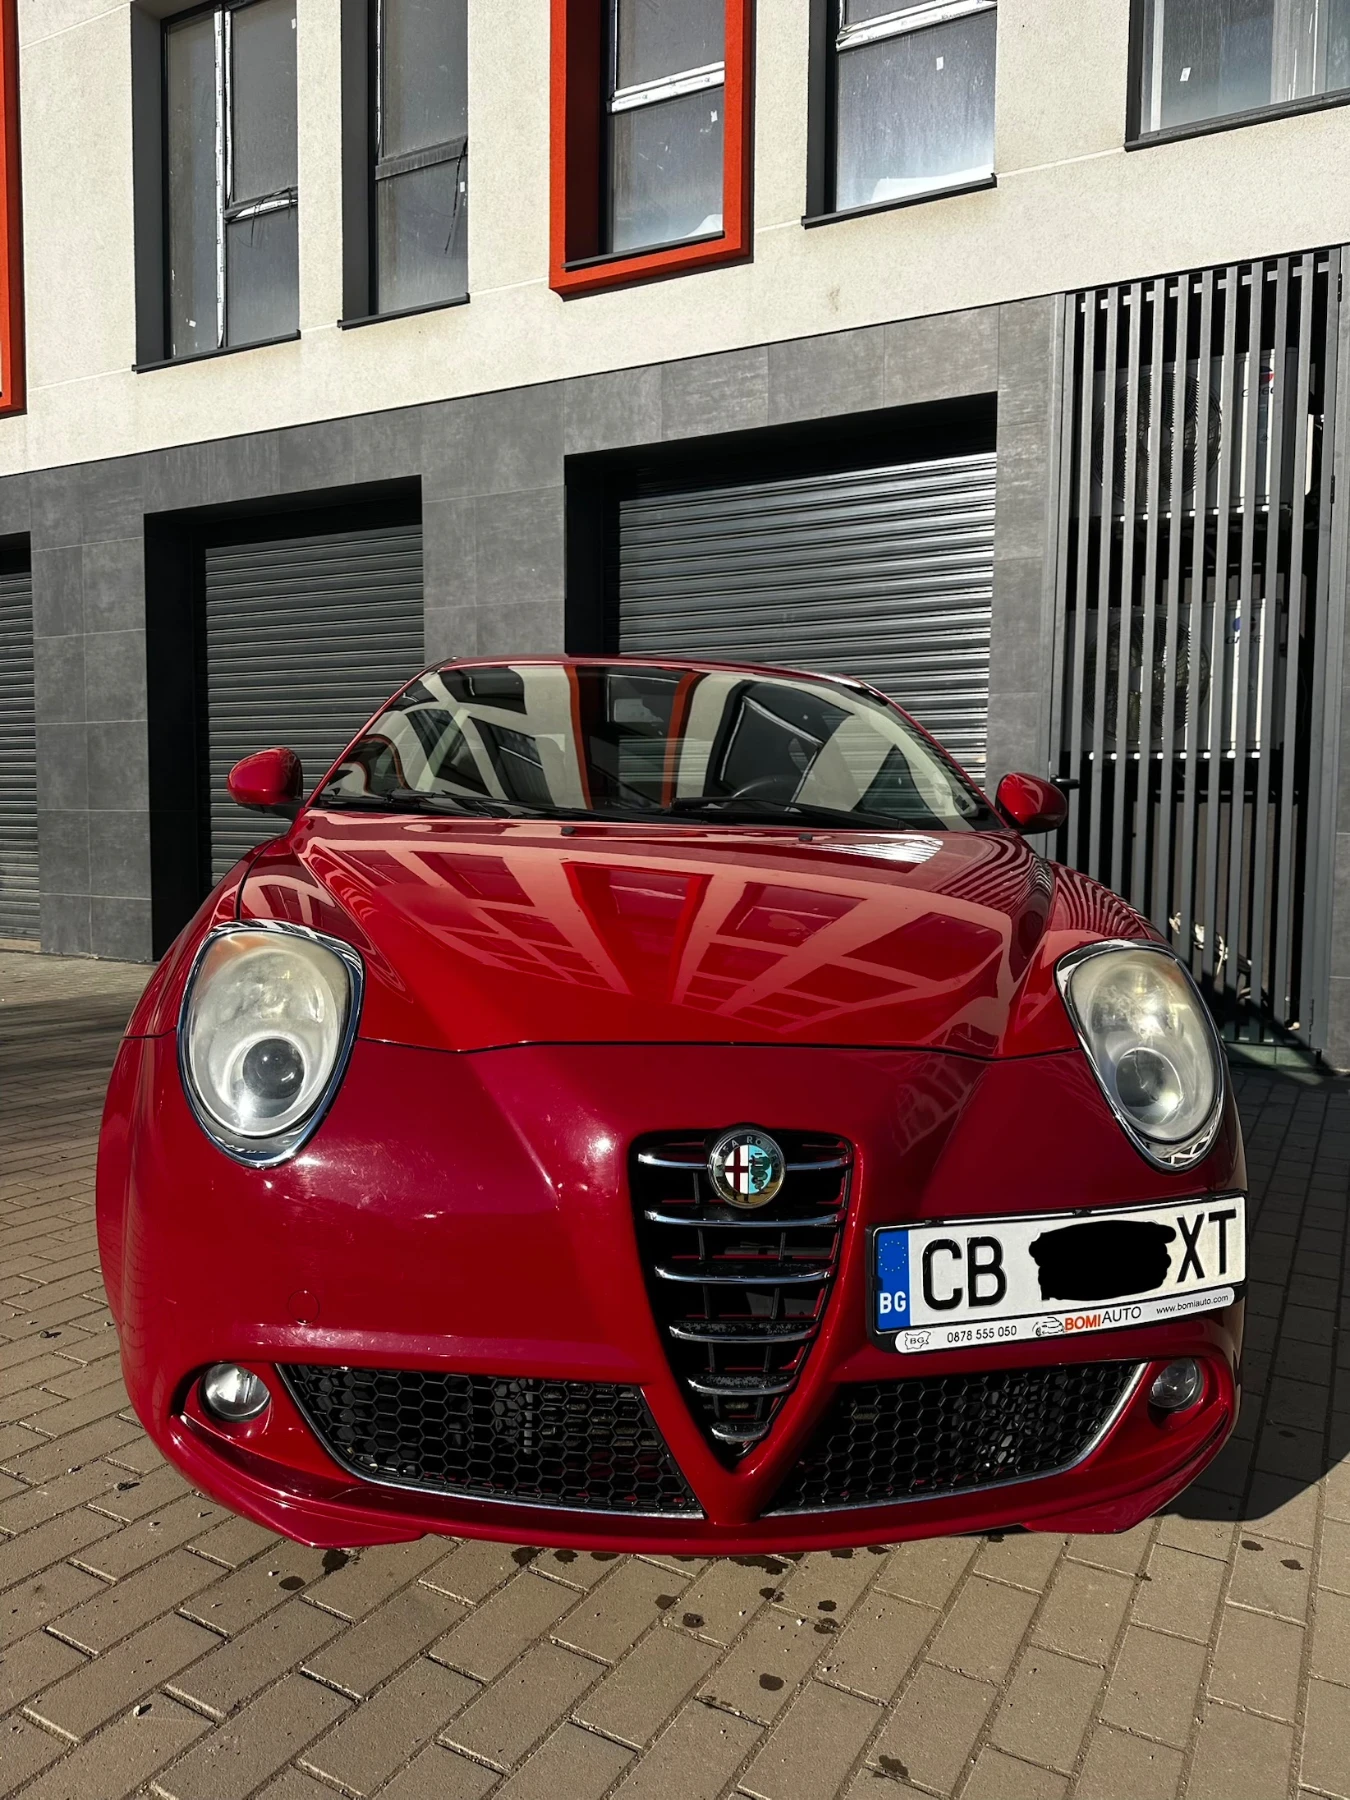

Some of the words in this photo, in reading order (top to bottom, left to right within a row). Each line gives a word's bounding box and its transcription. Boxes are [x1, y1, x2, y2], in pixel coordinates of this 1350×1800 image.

[921, 1235, 1007, 1311] CB
[1176, 1208, 1237, 1284] XT
[879, 1291, 907, 1315] BG
[1156, 1294, 1229, 1315] www.bomiauto.com
[909, 1336, 925, 1345] BG
[946, 1330, 973, 1343] 0878
[975, 1327, 994, 1340] 555
[997, 1325, 1018, 1337] 050
